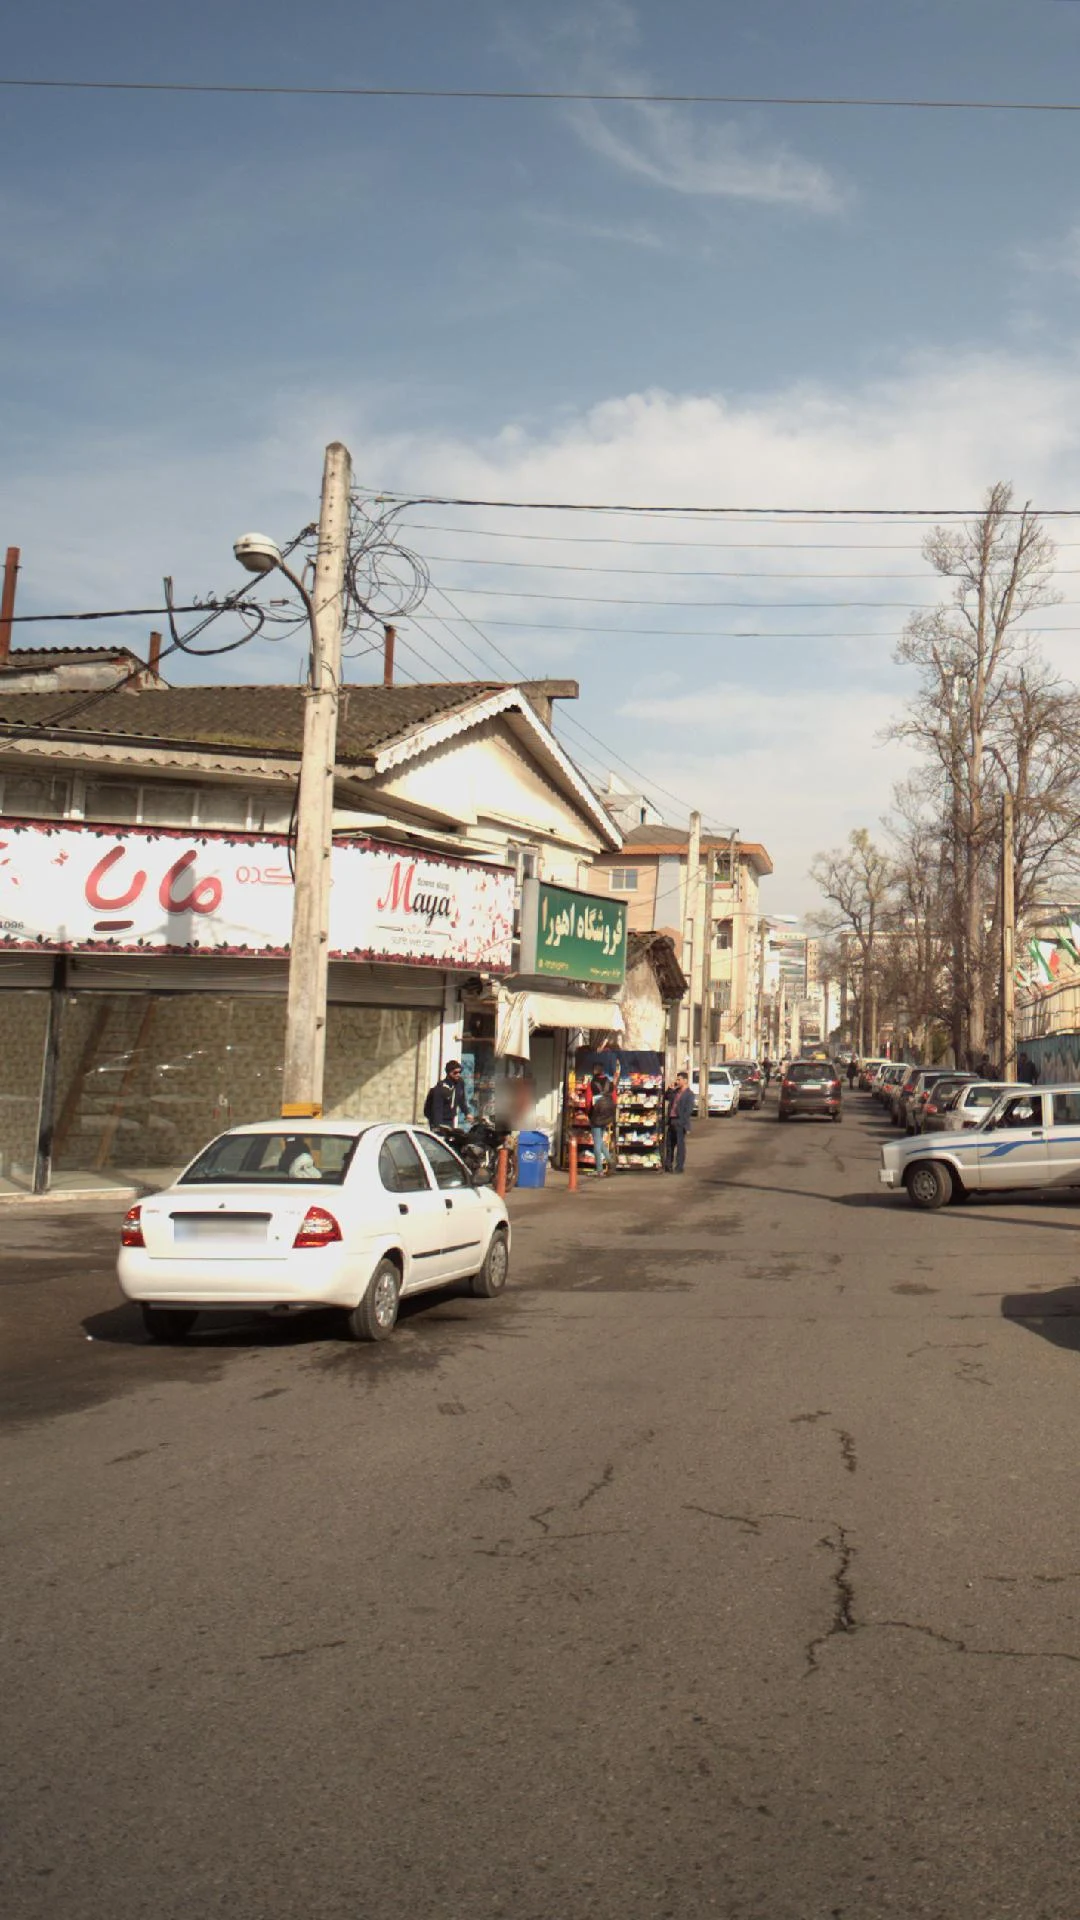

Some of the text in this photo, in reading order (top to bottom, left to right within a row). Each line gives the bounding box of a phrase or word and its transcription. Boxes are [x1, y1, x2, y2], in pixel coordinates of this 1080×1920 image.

[377, 861, 452, 927] Maya
[542, 896, 622, 955] فروشگاه اهورا
